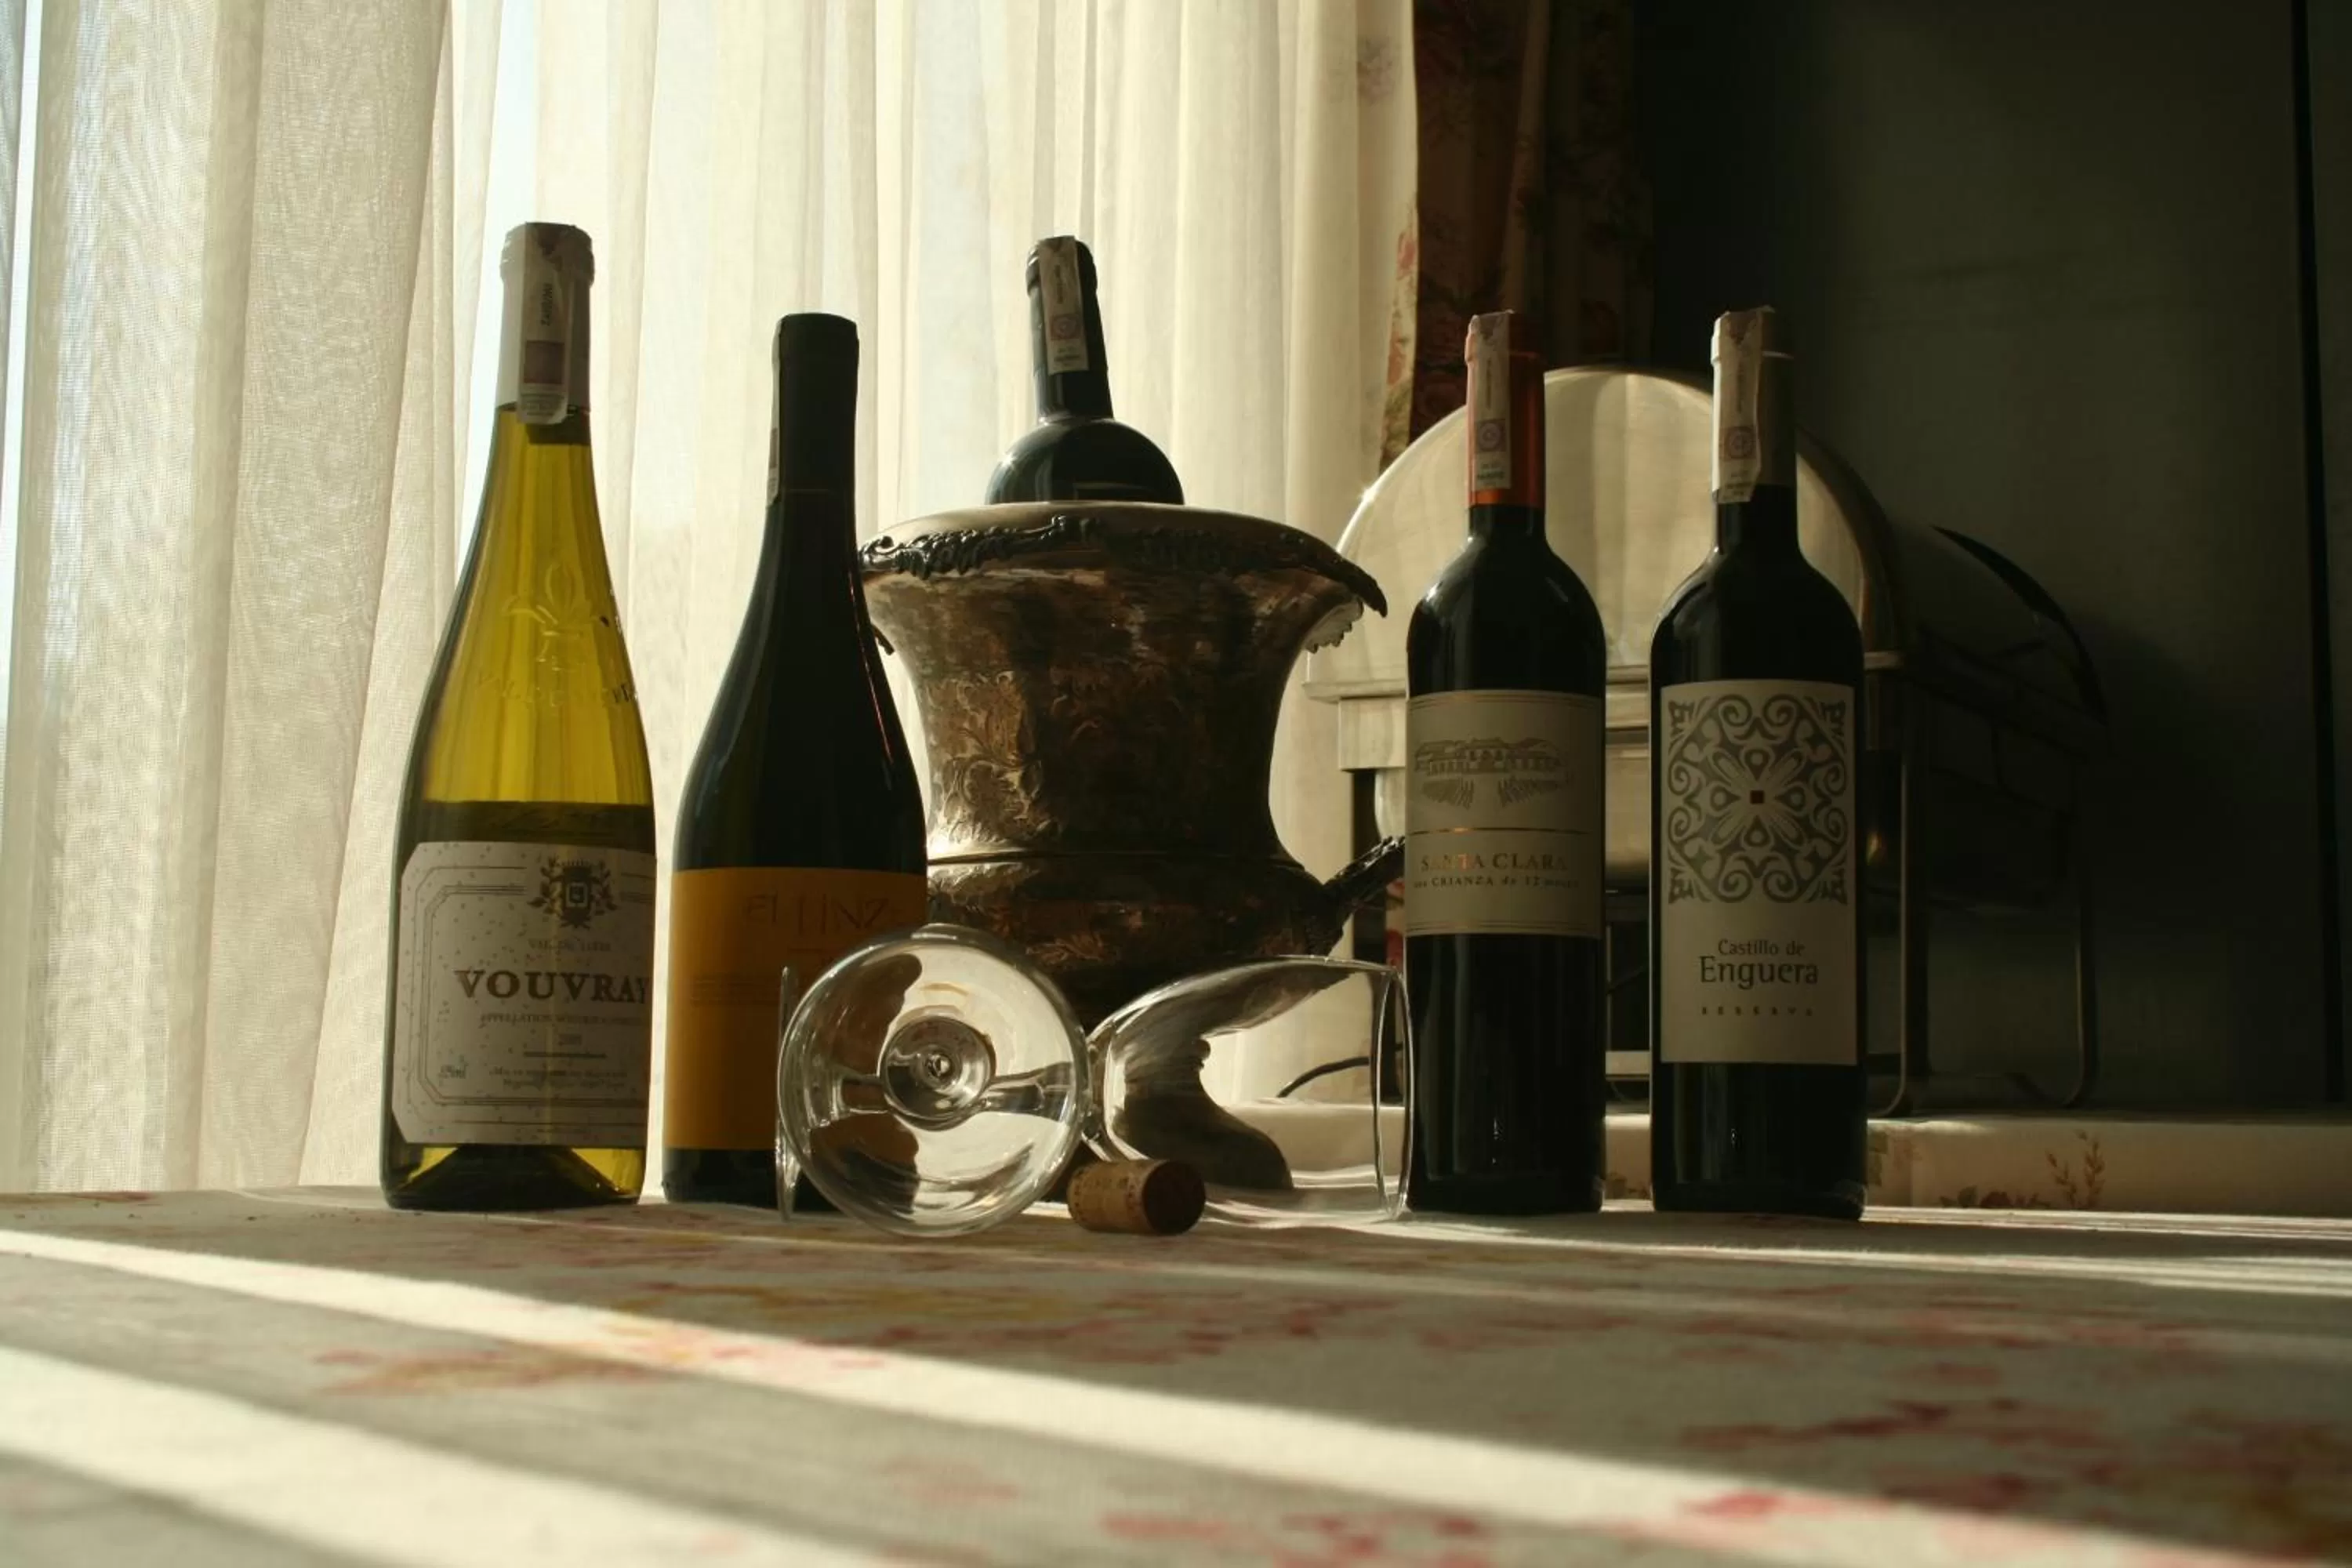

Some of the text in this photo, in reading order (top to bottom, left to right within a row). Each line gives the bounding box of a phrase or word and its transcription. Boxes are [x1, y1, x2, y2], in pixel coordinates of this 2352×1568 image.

[1492, 852, 1569, 870] CLARA
[1431, 875, 1494, 887] CRIANZA
[1717, 938, 1806, 956] Castillo de
[1699, 955, 1819, 990] Enguera
[453, 968, 650, 1004] VOUVRAY
